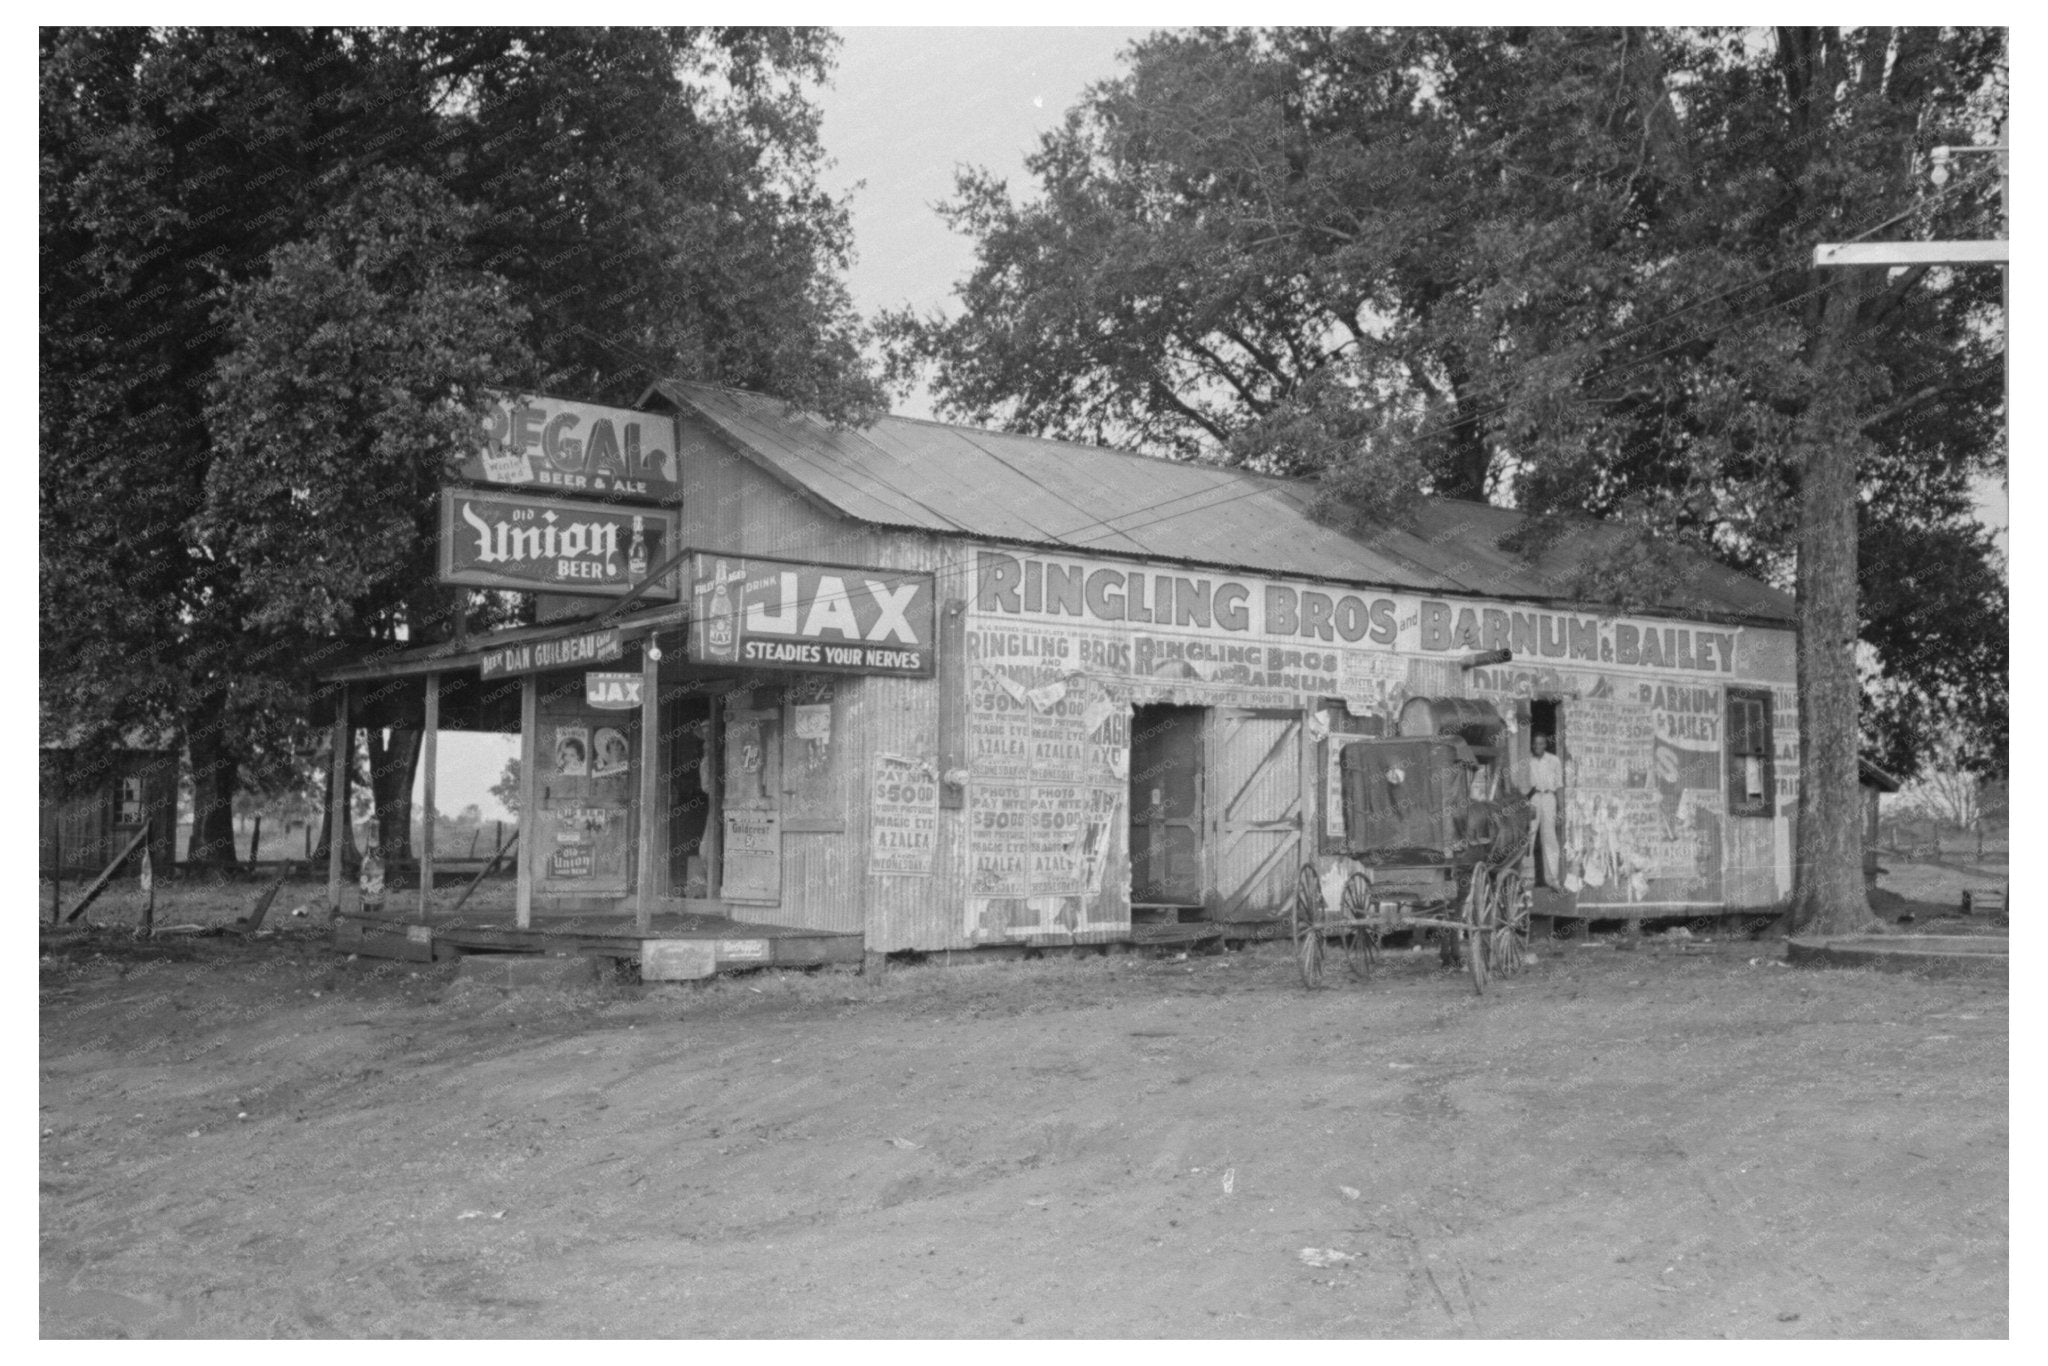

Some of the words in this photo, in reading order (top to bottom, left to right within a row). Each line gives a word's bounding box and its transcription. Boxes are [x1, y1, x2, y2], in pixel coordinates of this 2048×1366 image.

[539, 471, 587, 488] BEER
[594, 476, 606, 489] &
[613, 479, 647, 493] ALE
[462, 502, 620, 577] Union
[557, 559, 603, 579] BEER
[746, 575, 777, 592] DRINK
[746, 571, 920, 644] JAX
[976, 551, 1250, 631] RINGLING
[1264, 584, 1398, 645] BROS
[1399, 613, 1418, 631] and
[1420, 600, 1598, 661] BARNUM
[1600, 636, 1614, 663] &
[1615, 623, 1736, 672] BAILEY
[505, 647, 530, 671] DAN
[534, 635, 595, 667] GUILBEAU
[745, 641, 821, 663] STEADIES
[825, 646, 862, 666] YOUR
[866, 650, 921, 670] NERVES
[966, 631, 1069, 660] RINGLING
[1079, 638, 1131, 674] BROS
[1134, 637, 1262, 676] RINGLING
[1267, 648, 1337, 673] BROS
[1041, 658, 1061, 666] AND
[1235, 664, 1337, 694] BARNUM
[588, 682, 640, 701] JAX
[978, 739, 1026, 755] AZALEA
[1035, 743, 1082, 759] AZALEA
[876, 770, 903, 781] PAY
[980, 787, 1020, 798] PHOTO
[1037, 788, 1076, 798] PHOTO
[971, 798, 998, 808] PAY
[1030, 799, 1055, 810] PAY
[1057, 799, 1082, 810] NITE
[874, 817, 910, 828] MAGIC
[915, 818, 934, 829] EYE
[878, 831, 929, 849] AZALEA
[977, 856, 1023, 873] AZALEA
